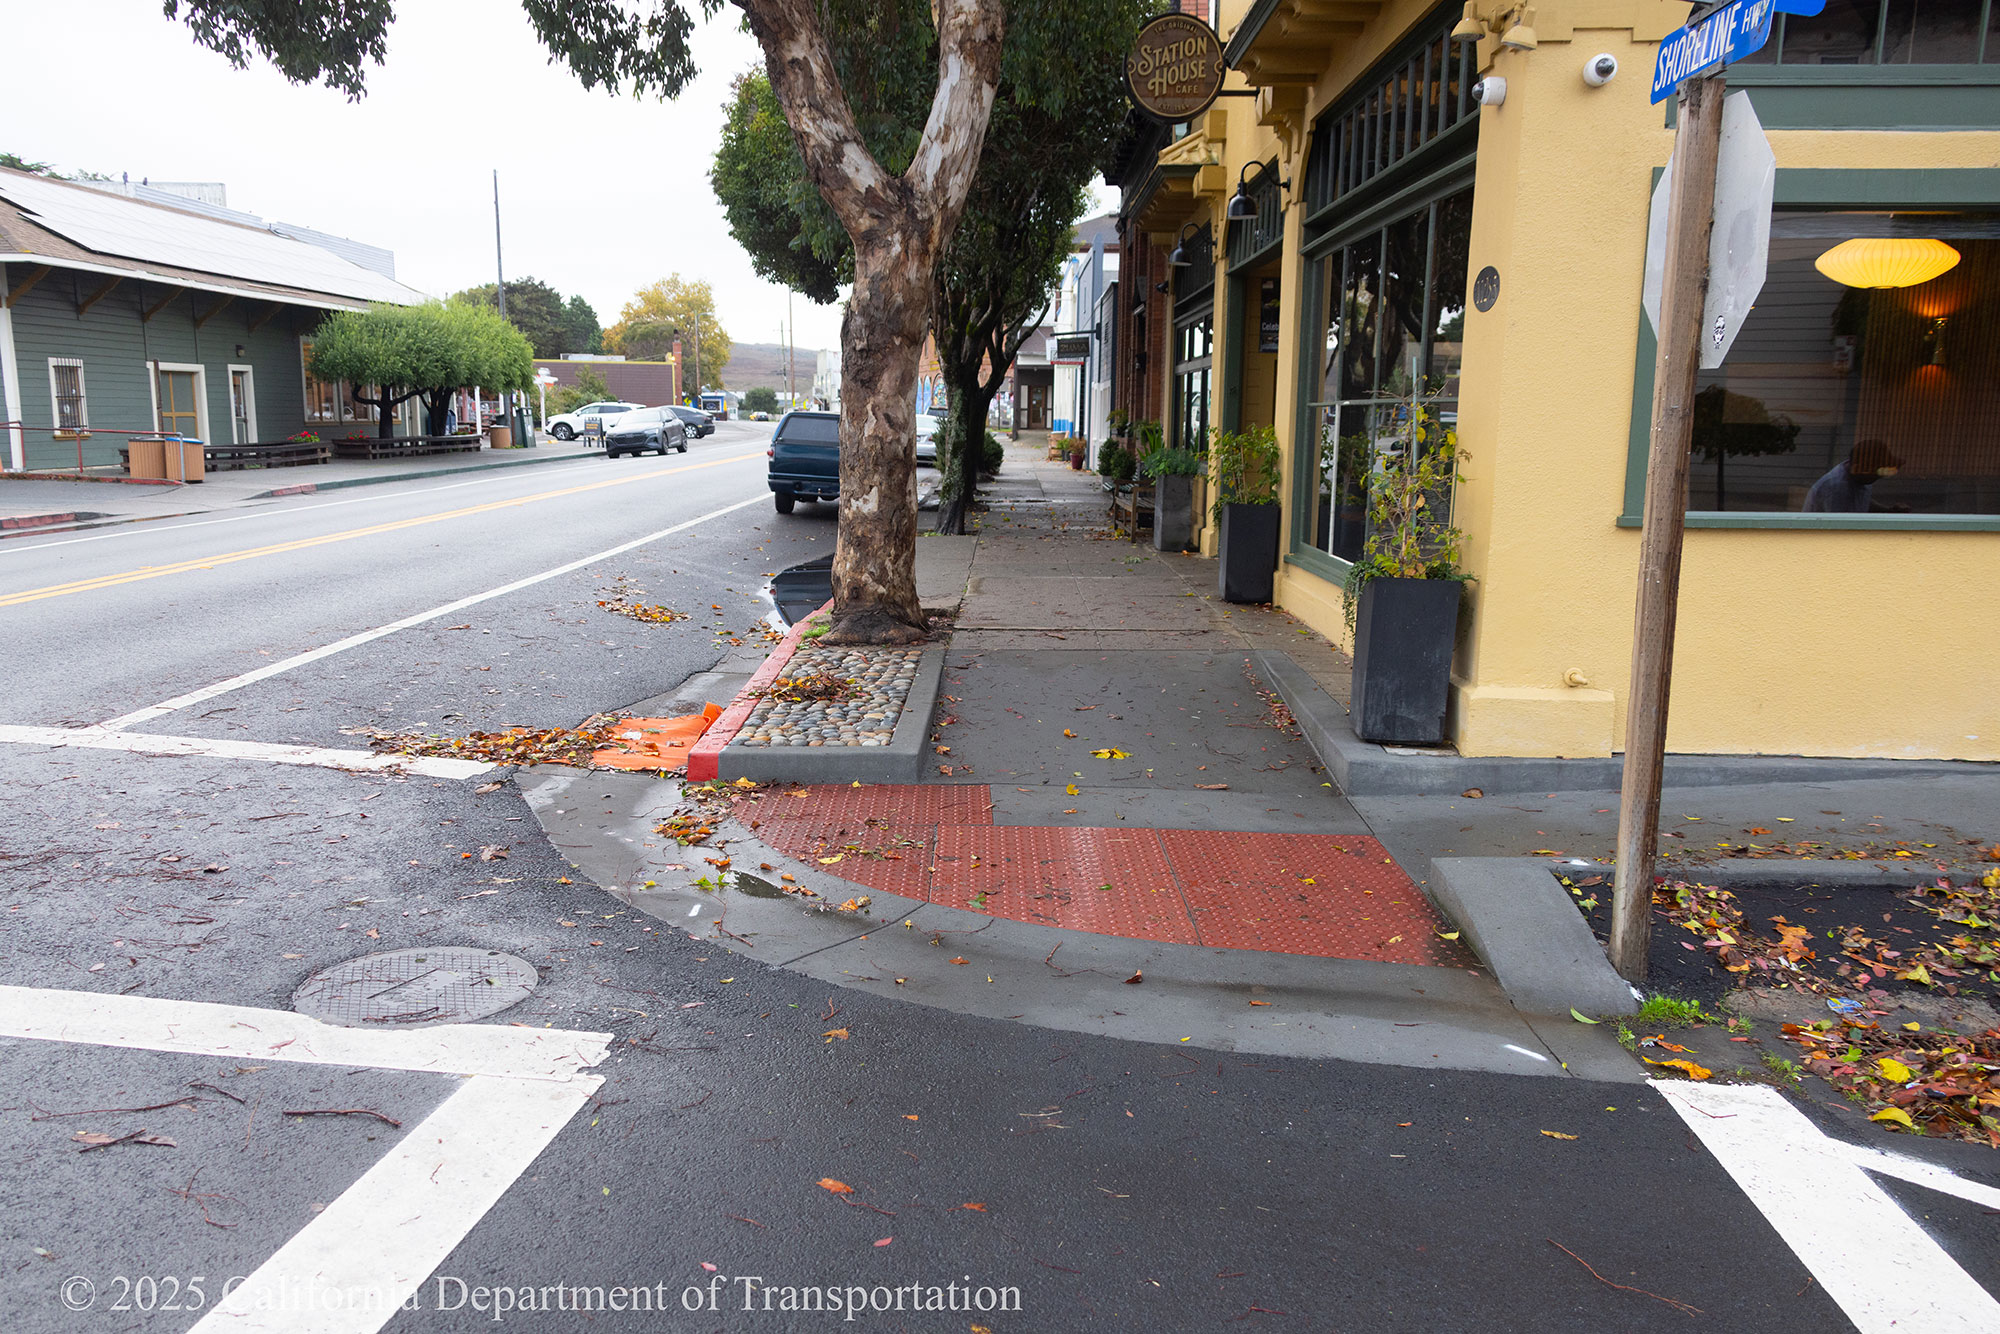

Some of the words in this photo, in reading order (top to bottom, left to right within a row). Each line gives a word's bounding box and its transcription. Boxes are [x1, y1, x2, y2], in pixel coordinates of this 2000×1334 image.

[1168, 21, 1198, 33] ORIGINAL
[1138, 36, 1208, 76] STATION
[1654, 1, 1742, 92] SHORELINE
[1147, 60, 1207, 97] HOUSE
[1175, 85, 1199, 94] CAFE
